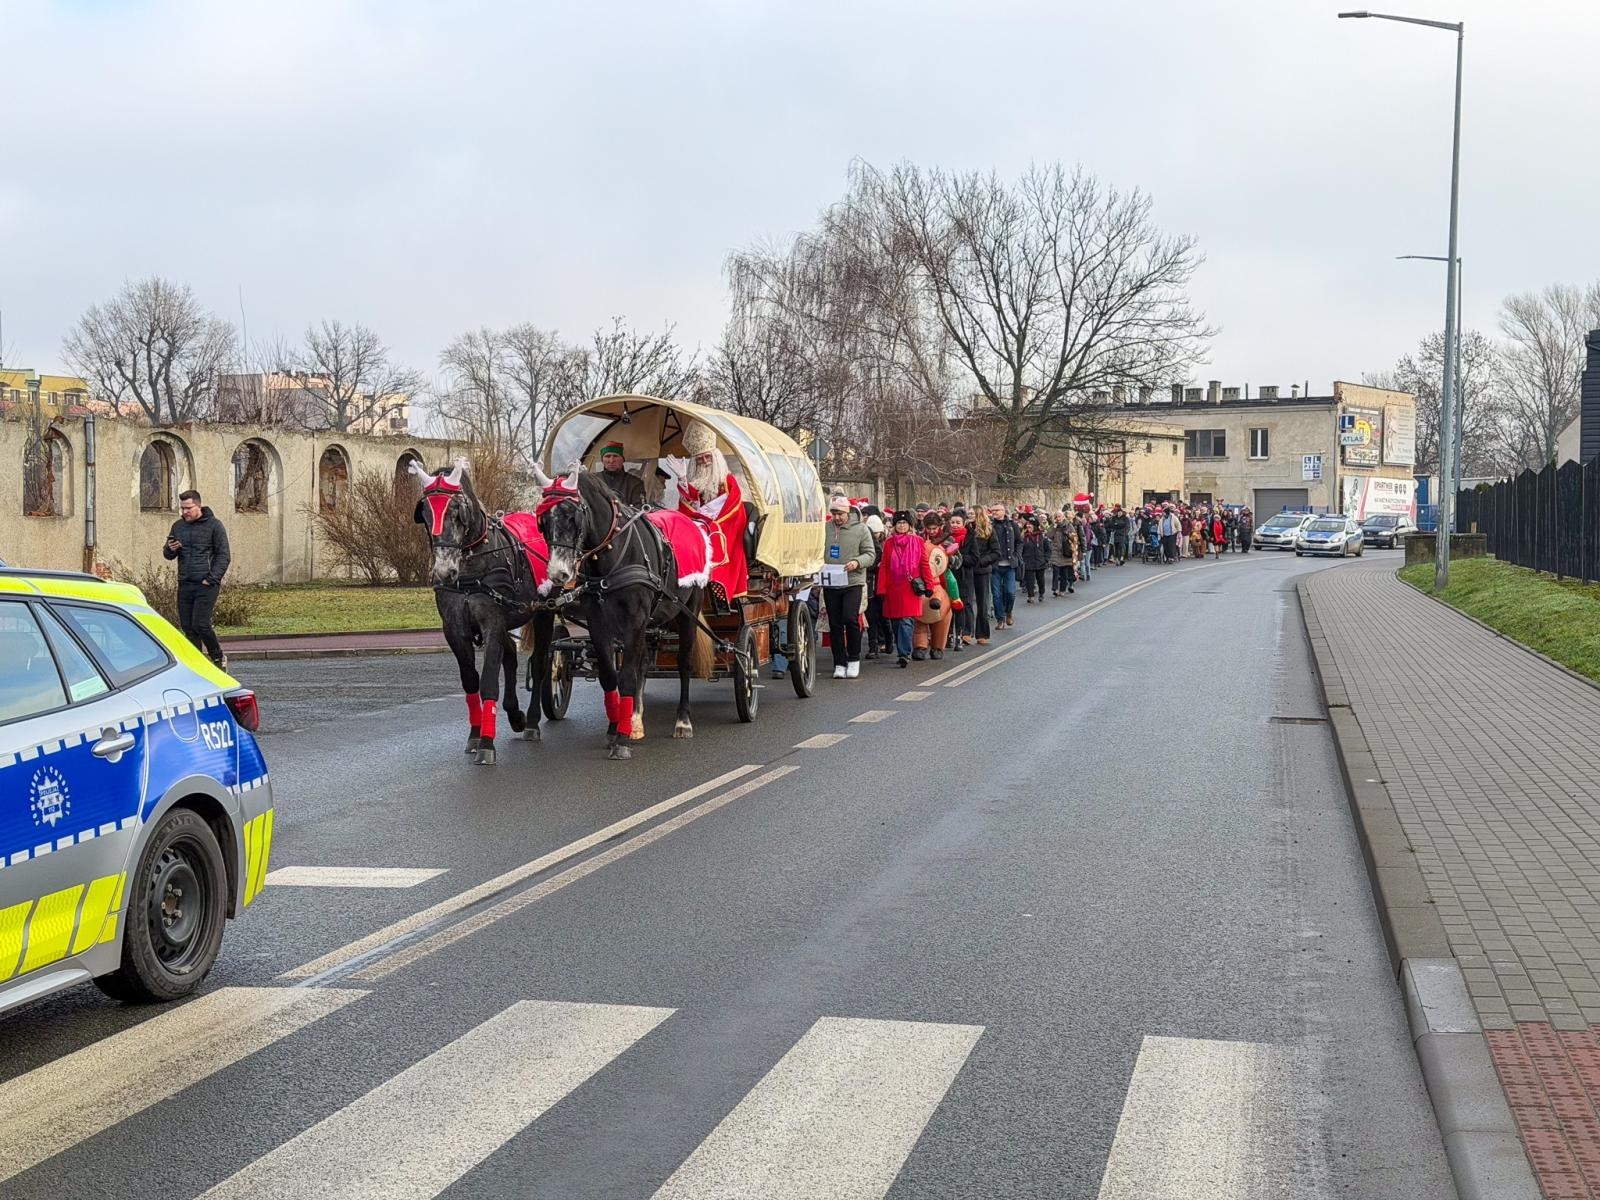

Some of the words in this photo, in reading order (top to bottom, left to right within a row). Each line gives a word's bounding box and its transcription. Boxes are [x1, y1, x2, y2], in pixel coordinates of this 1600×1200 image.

[1345, 416, 1353, 428] L
[1342, 435, 1364, 443] ATLAS
[821, 572, 831, 586] H
[200, 719, 234, 750] R522
